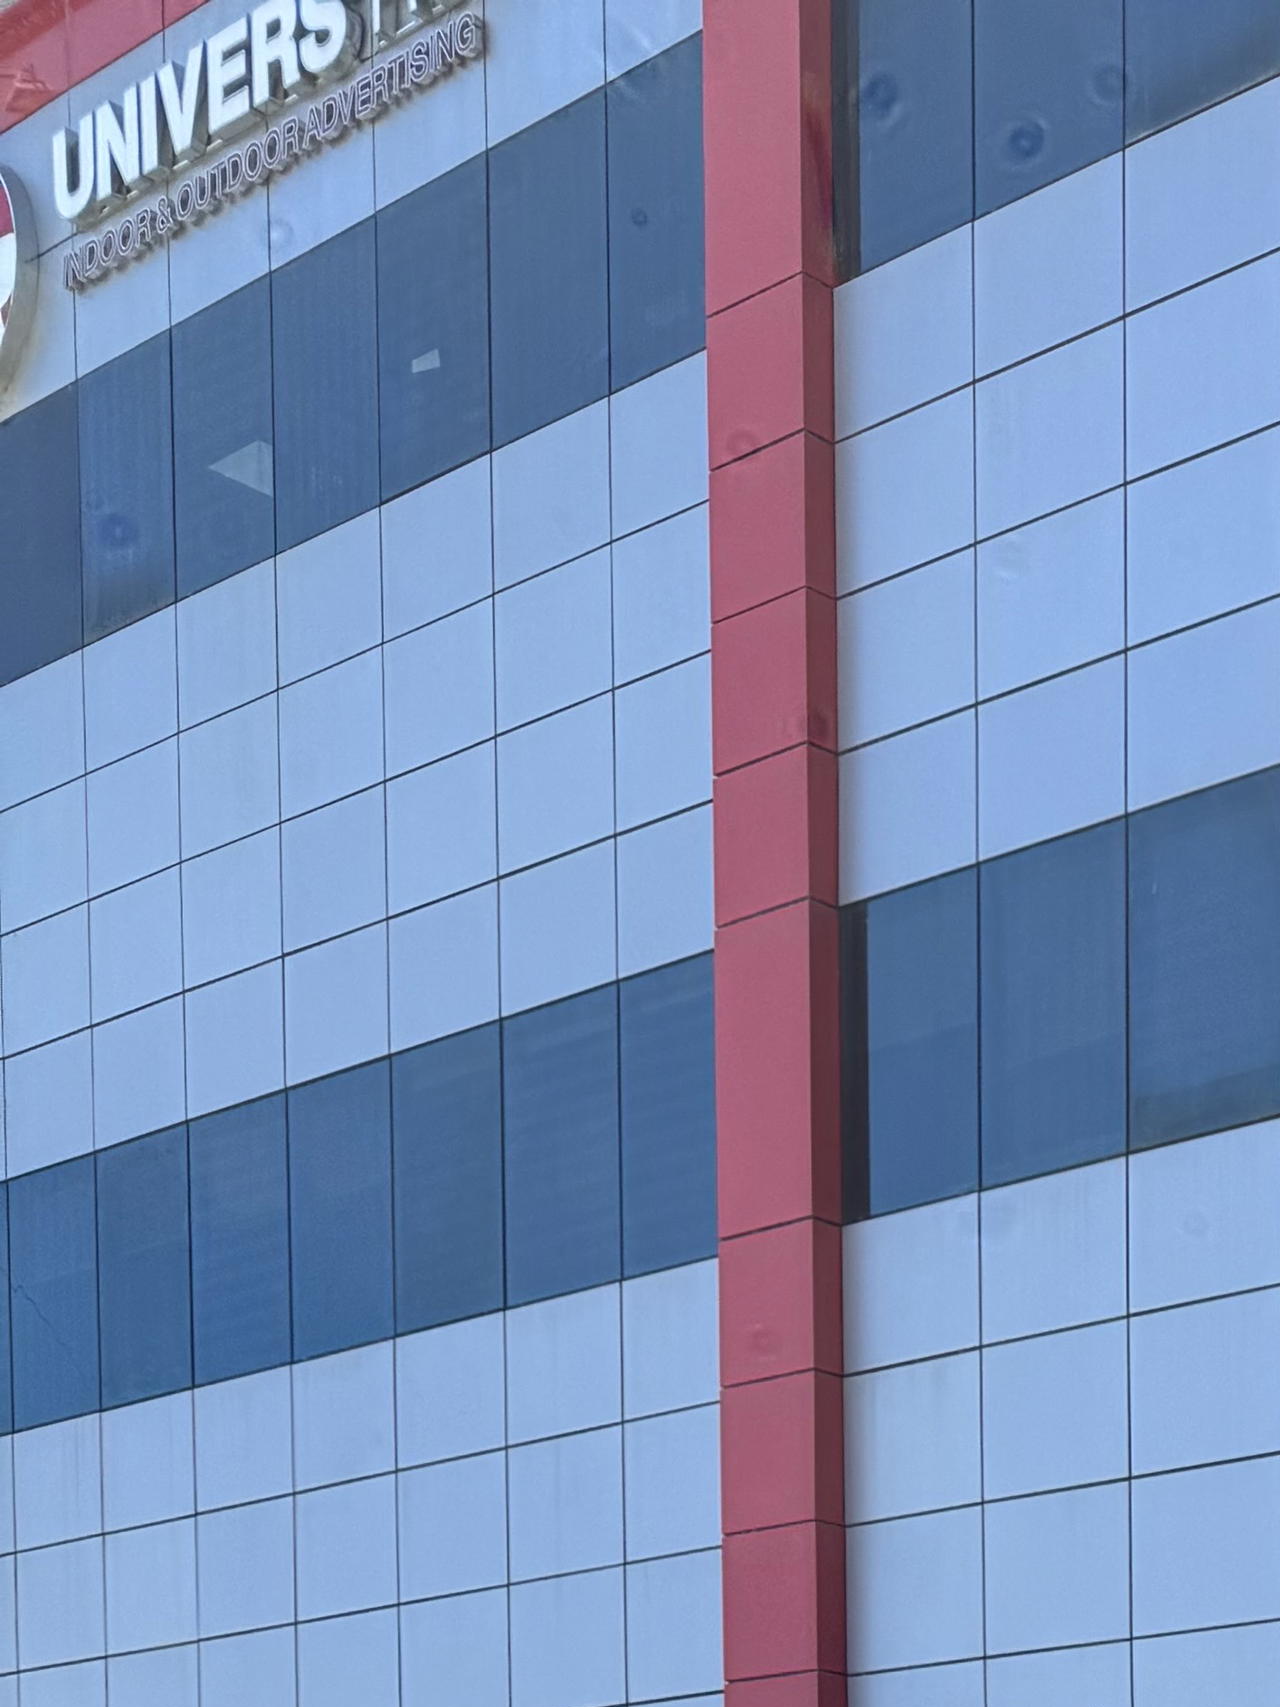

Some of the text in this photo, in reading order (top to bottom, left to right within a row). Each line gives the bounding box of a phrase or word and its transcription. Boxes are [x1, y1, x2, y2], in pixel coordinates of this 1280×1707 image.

[63, 11, 477, 289] INDOOR & OUTDOOR ADVERTISING
